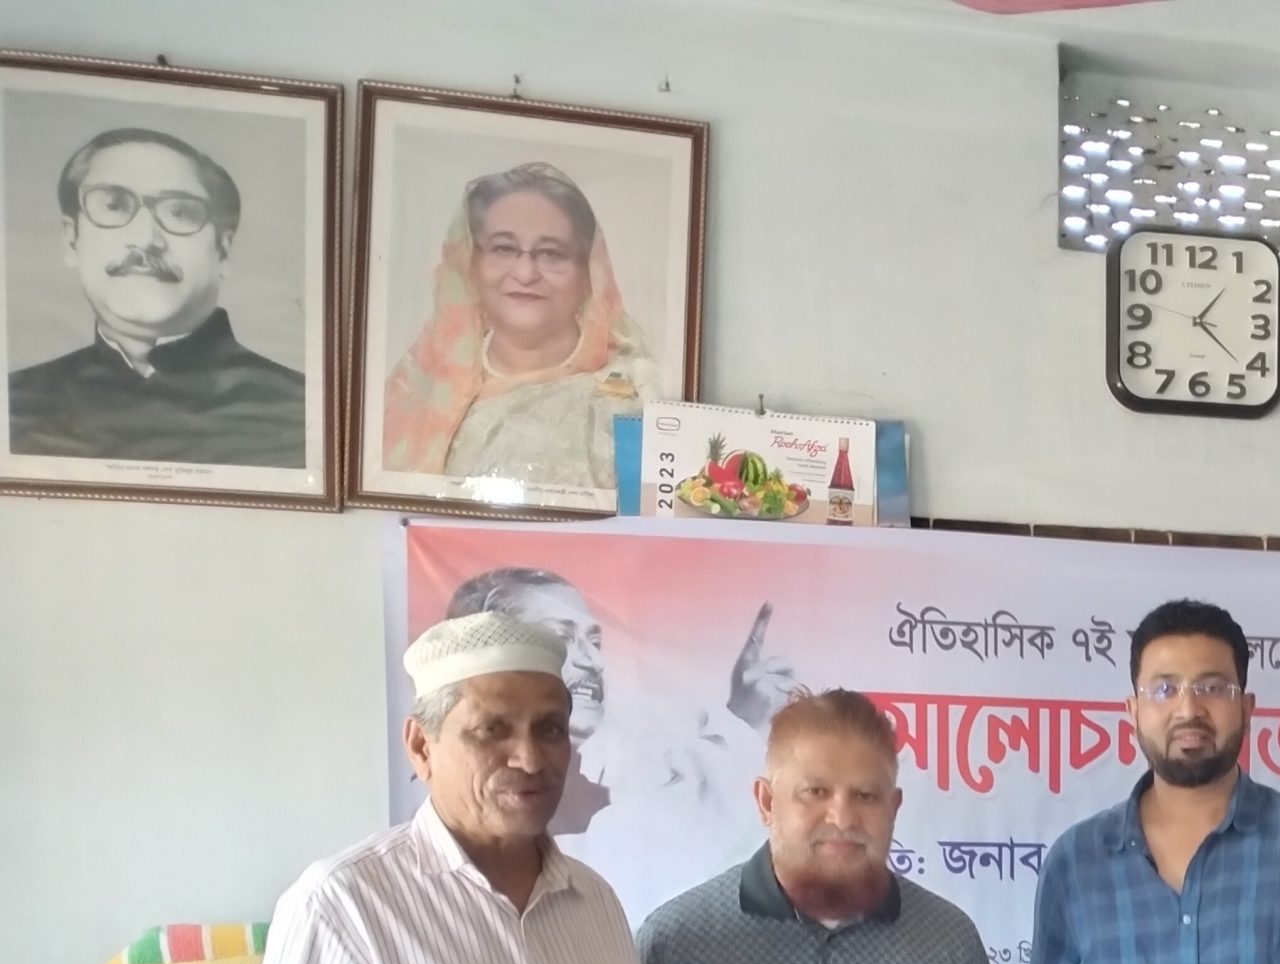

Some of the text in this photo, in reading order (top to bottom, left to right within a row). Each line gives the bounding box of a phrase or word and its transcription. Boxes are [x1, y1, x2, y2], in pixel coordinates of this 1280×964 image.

[1147, 242, 1174, 266] 11
[1185, 246, 1218, 270] 12
[1232, 251, 1244, 274] 1
[1124, 269, 1163, 295] 10
[1252, 279, 1272, 304] 2
[1126, 303, 1153, 331] 9
[1250, 314, 1271, 341] 3
[1126, 341, 1152, 369] 8
[1245, 352, 1270, 378] 4
[1154, 369, 1176, 395] 7
[1188, 371, 1211, 398] 6
[1226, 373, 1247, 400] 5
[658, 452, 675, 510] 2023
[889, 602, 1056, 662] ঐতিহাসিক
[1071, 615, 1117, 668] ৭ই
